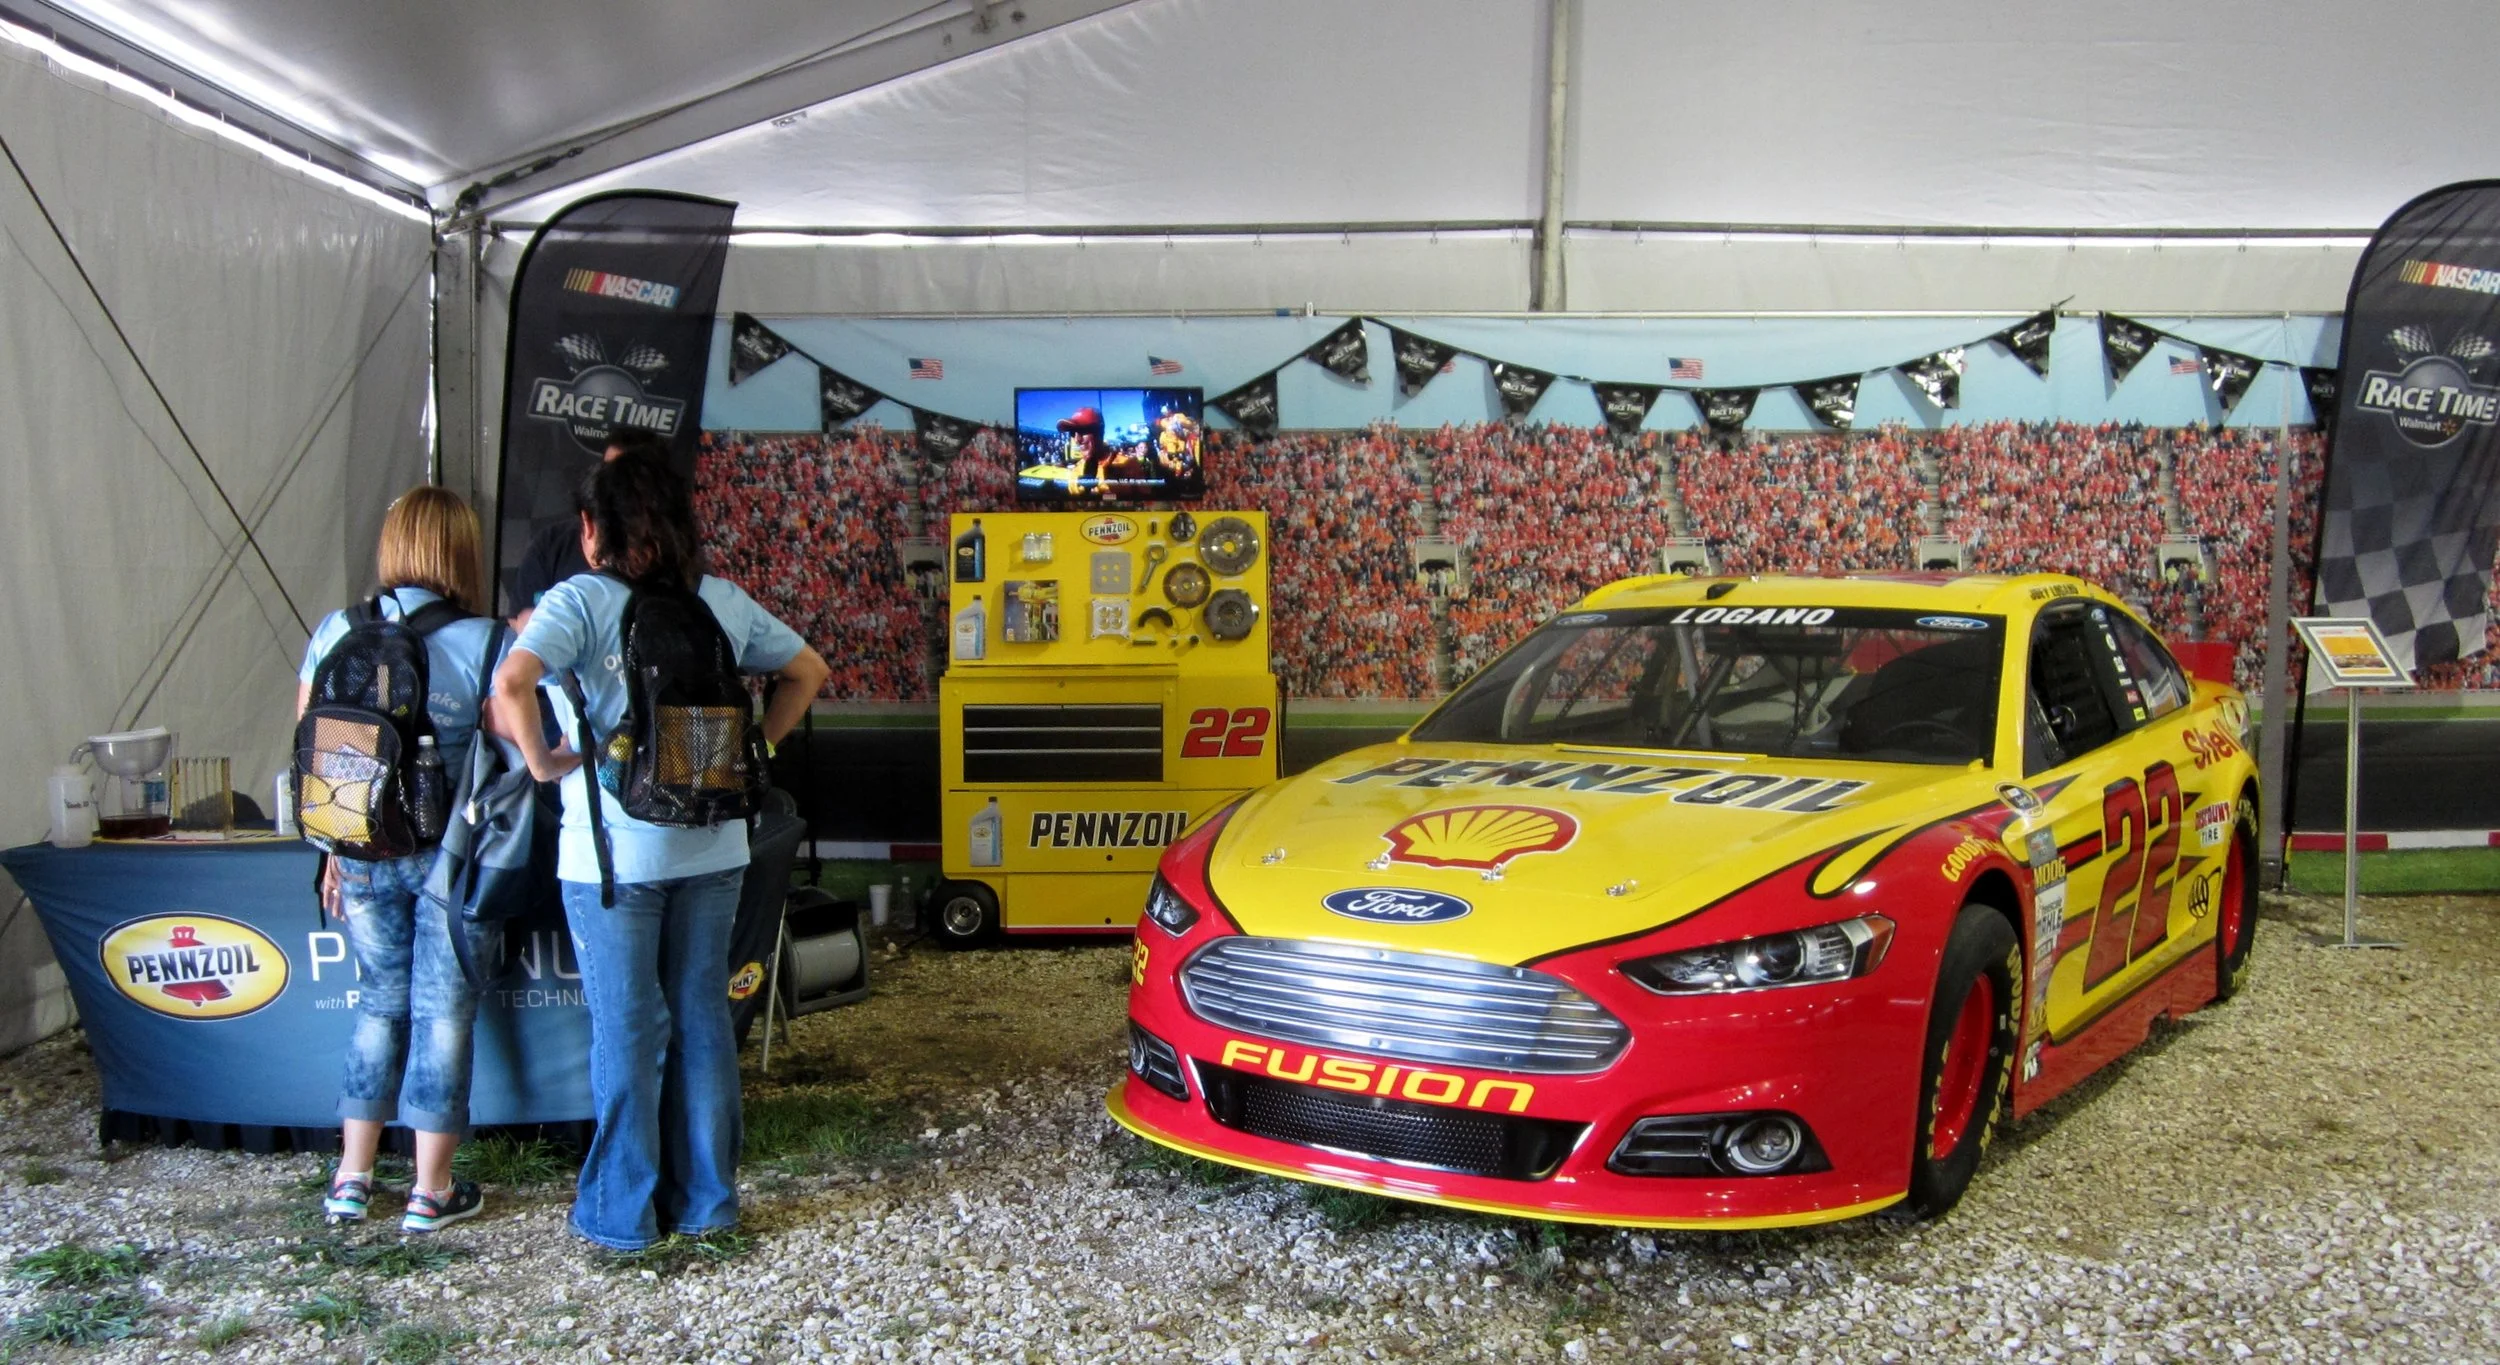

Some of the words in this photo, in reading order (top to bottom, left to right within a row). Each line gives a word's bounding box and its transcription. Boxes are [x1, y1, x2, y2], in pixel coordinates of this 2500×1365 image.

[599, 273, 676, 308] NASCAR
[2432, 264, 2500, 295] NASCAR
[535, 384, 608, 421] RACE
[613, 395, 676, 430] TIME
[2364, 377, 2435, 411] RACE
[2438, 386, 2497, 420] TIME
[2399, 416, 2441, 432] Walmart
[1088, 522, 1131, 537] PENNZOIL
[1670, 608, 1836, 626] LOGANO
[1179, 707, 1271, 758] 22
[2183, 718, 2241, 770] Shell
[1333, 757, 1870, 813] PENNZOIL
[2201, 827, 2219, 844] TIRE
[2033, 855, 2066, 889] MOOG
[2082, 759, 2182, 996] 22
[1347, 889, 1440, 918] Ford
[126, 944, 261, 984] PENNZOIL
[315, 995, 345, 1009] with
[1221, 1039, 1535, 1113] FUSION
